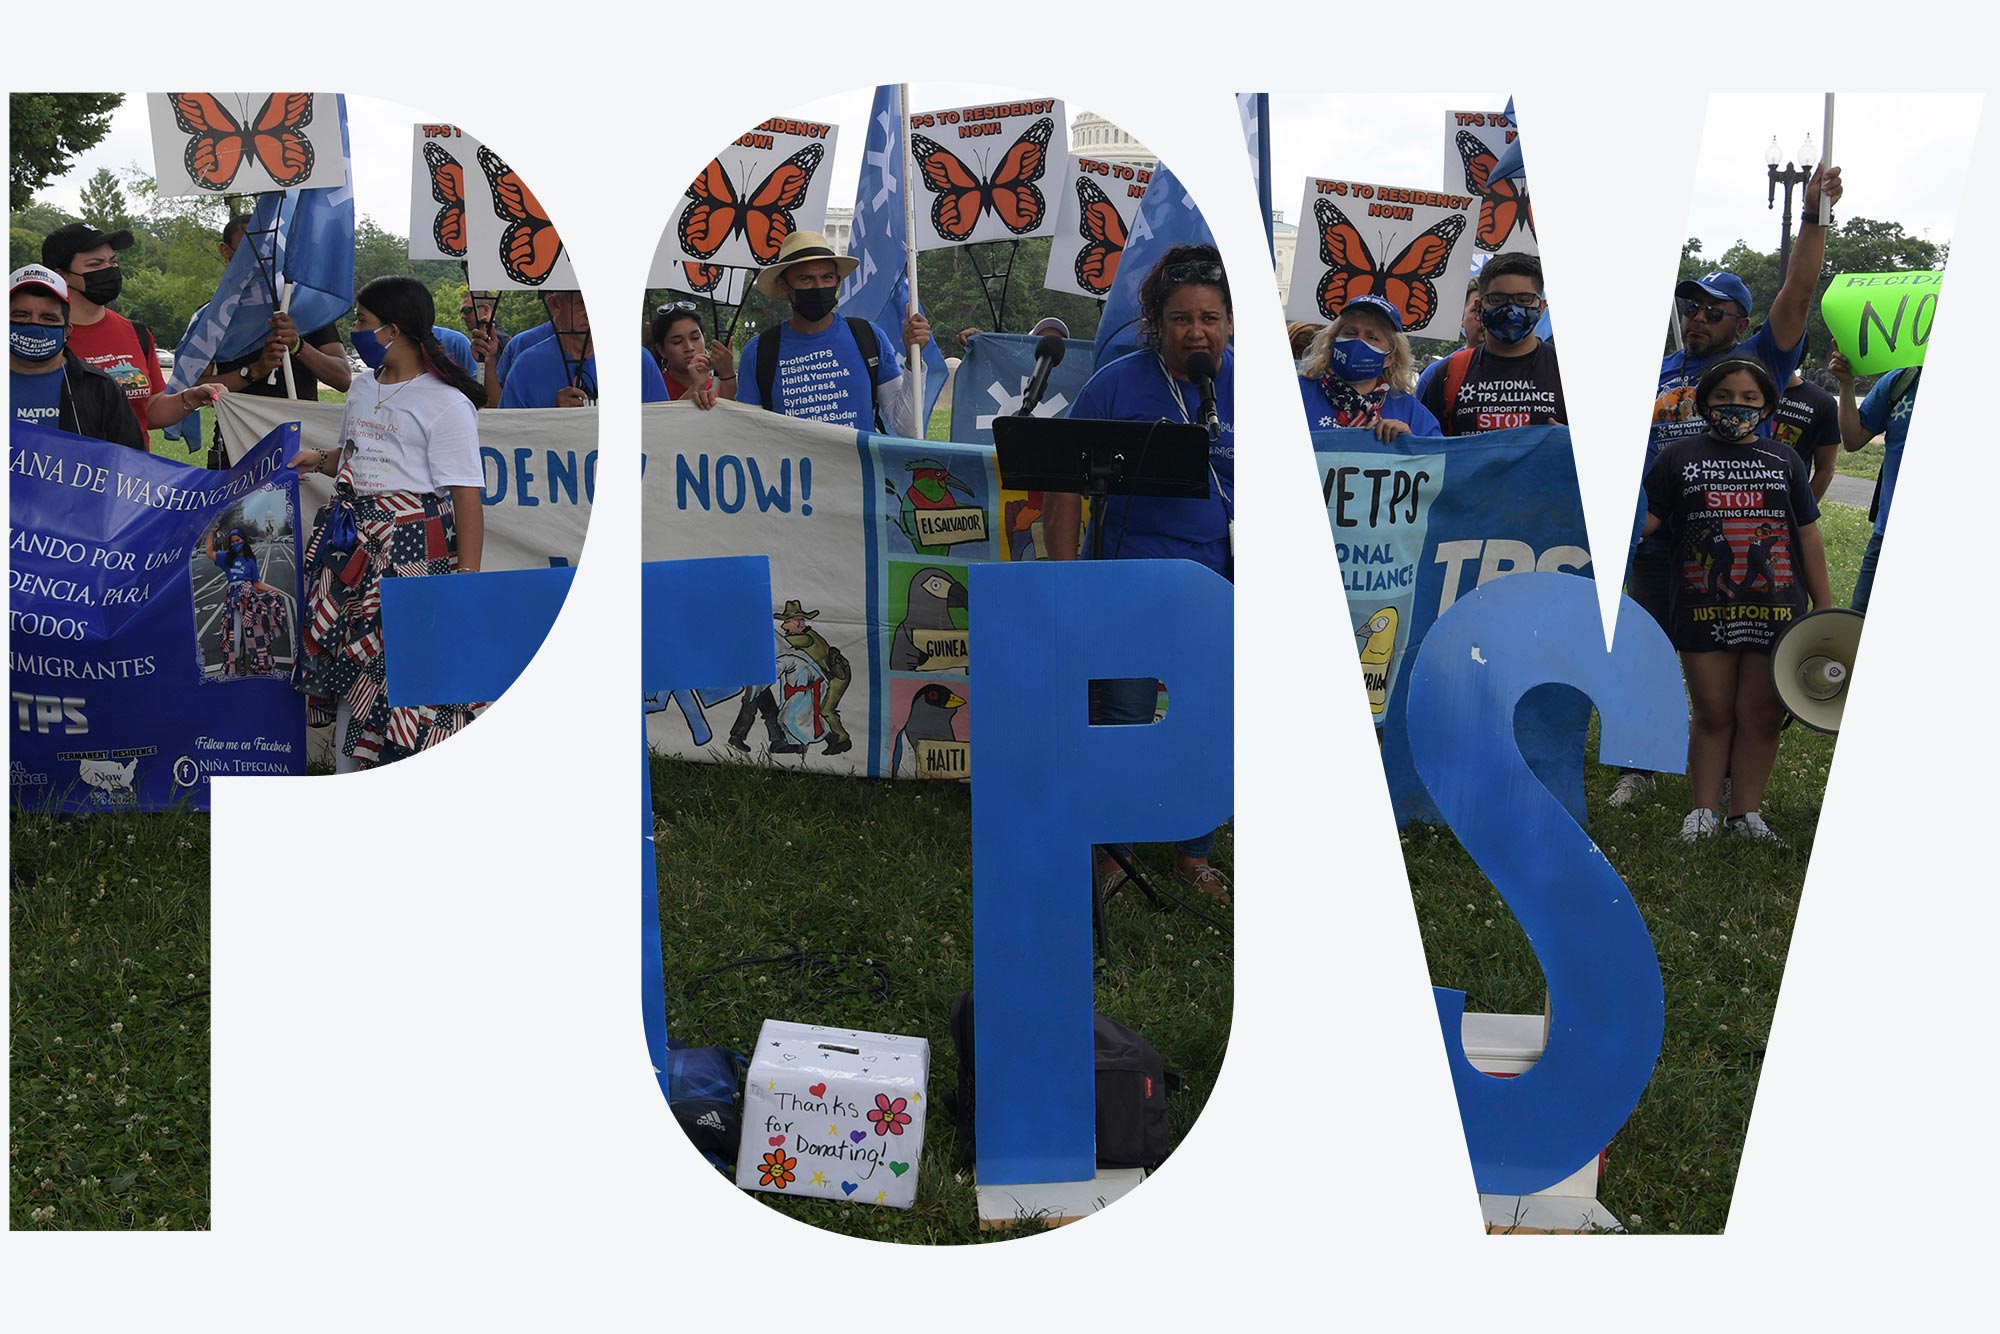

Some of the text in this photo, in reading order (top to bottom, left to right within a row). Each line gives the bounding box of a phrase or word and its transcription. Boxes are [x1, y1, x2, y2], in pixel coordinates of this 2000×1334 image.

[910, 100, 1055, 130] PS TO RESIDENCY
[1455, 112, 1485, 127] TPS
[423, 124, 451, 138] TPS
[753, 117, 831, 139] SIDENCY
[958, 122, 1002, 139] NOW!
[1079, 158, 1109, 176] TPS
[1113, 164, 1134, 180] TO
[1316, 179, 1473, 211] TPS TO RESIDENCY
[1367, 203, 1414, 221] NOW!
[780, 349, 833, 367] ProtectTPS
[1333, 347, 1348, 365] TPS
[781, 359, 839, 376] ElSalvador&
[782, 381, 836, 396] Honduras&
[1478, 380, 1536, 391] NATIONAL
[783, 389, 849, 408] Syria&Nepal&
[1477, 392, 1555, 402] TPS ALLIANCE
[785, 402, 838, 416] Nicaragua&
[1782, 410, 1812, 424] ALLIANCE
[1479, 413, 1531, 429] STOP
[1668, 420, 1708, 431] NATIONAL
[1702, 460, 1766, 469] NATIONAL
[70, 462, 110, 494] DE
[116, 464, 257, 512] WASHINGTON
[259, 447, 284, 480] DC
[1702, 470, 1784, 480] TPS ALLIANCE
[675, 452, 813, 517] NOW!
[1710, 483, 1748, 491] DEPORT
[1708, 491, 1762, 507] STOP
[1713, 534, 1725, 544] ICE
[90, 547, 136, 572] POR
[144, 546, 183, 571] UNA
[101, 583, 150, 607] PARA
[1693, 605, 1793, 622] JUSTICE FOR TPS
[1754, 621, 1768, 629] TPS
[926, 639, 968, 659] GUINEA
[12, 691, 89, 735] TPS
[58, 746, 157, 760] PERMANENT RESIDENCE
[195, 736, 292, 753] Follow me on Facebook
[925, 747, 966, 773] HAITI
[774, 1092, 860, 1119] Thanks
[696, 1118, 727, 1132] adidas
[764, 1115, 794, 1134] for
[796, 1134, 888, 1181] Donating!
